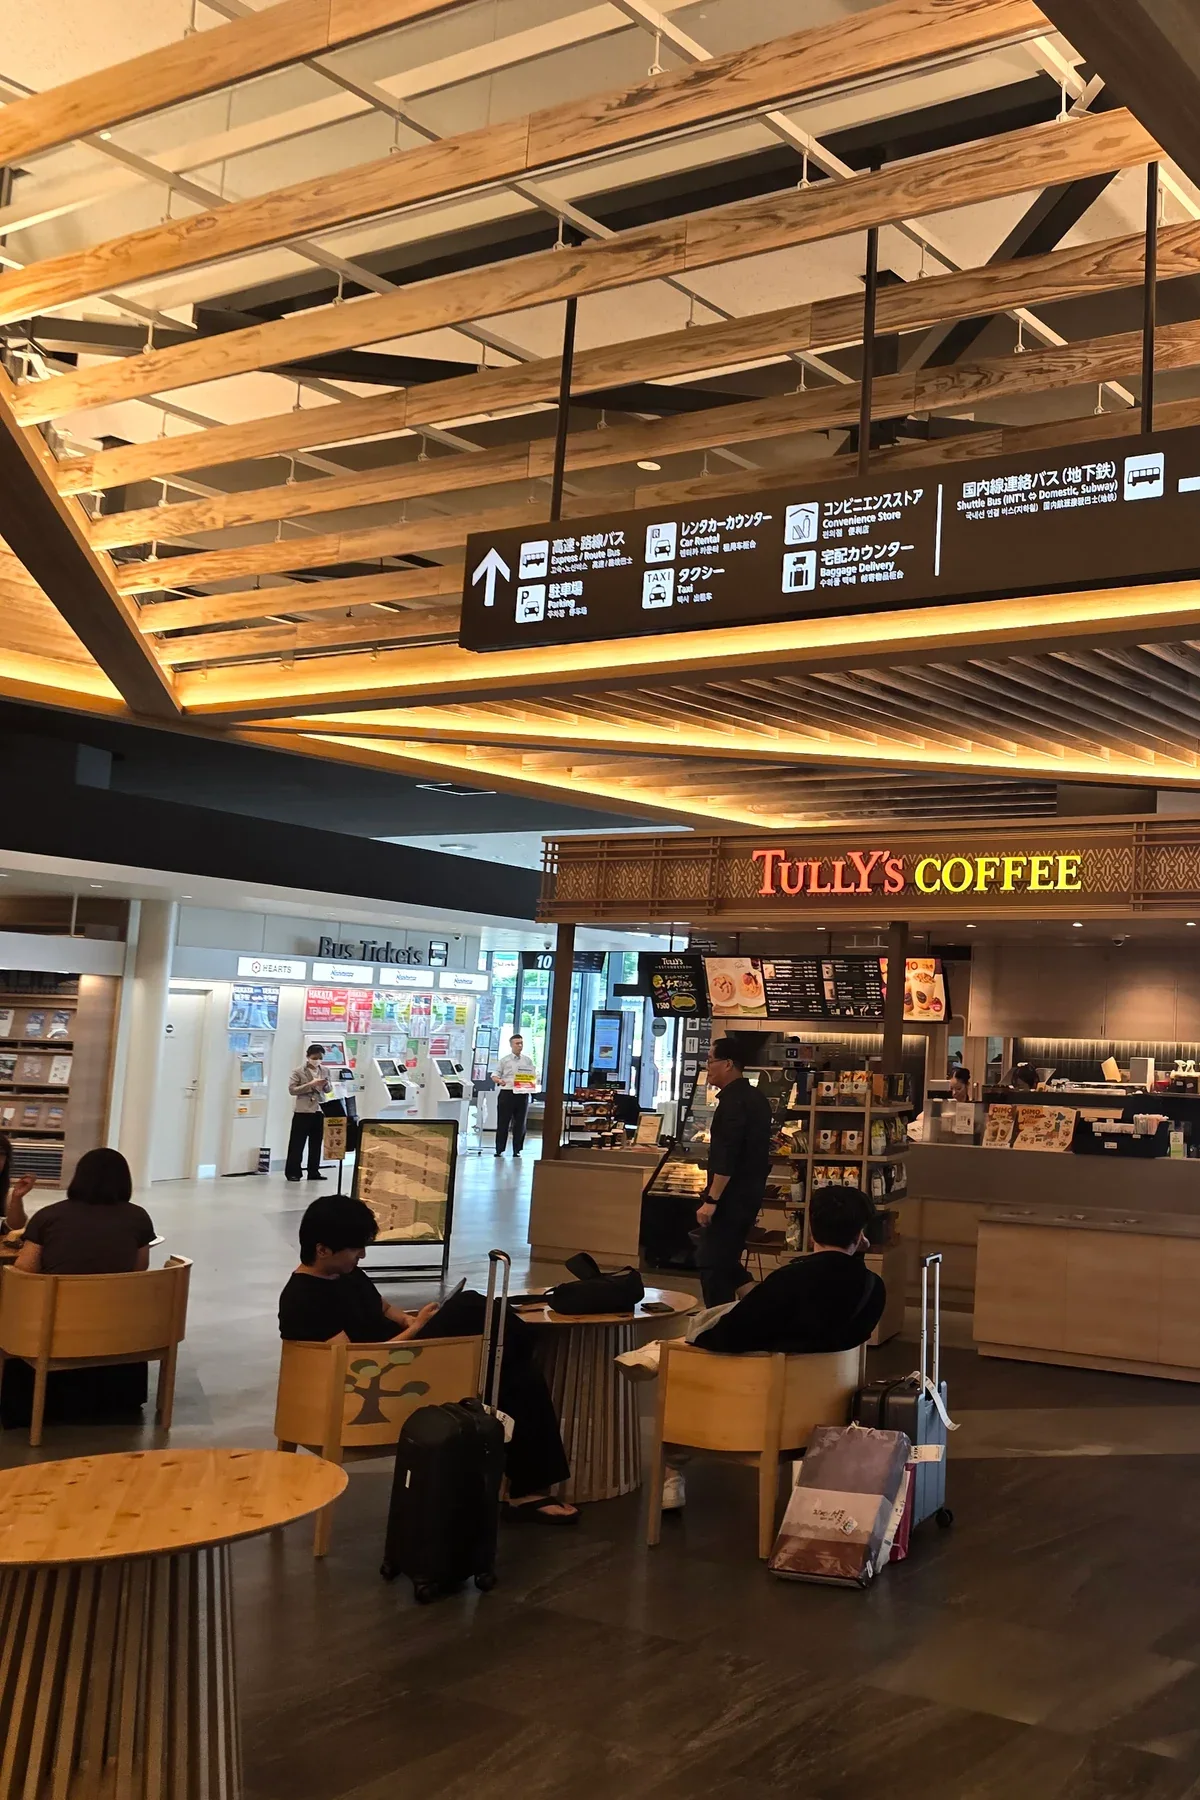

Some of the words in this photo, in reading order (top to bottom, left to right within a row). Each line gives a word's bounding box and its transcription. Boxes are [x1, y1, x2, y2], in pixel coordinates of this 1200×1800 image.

[823, 489, 923, 516] コンビニエンスストア
[957, 498, 985, 511] Shuttle
[987, 496, 1002, 507] Bus
[1003, 493, 1026, 506] (INT'L
[1039, 487, 1079, 499] Domestic,
[1081, 479, 1118, 494] Subway)
[681, 511, 772, 536] レンタカーカウンター
[822, 515, 876, 528] Convenience
[877, 510, 901, 522] Store
[680, 538, 694, 547] Car
[694, 533, 720, 546] Rental
[551, 554, 578, 565] Express
[584, 551, 606, 560] Route
[821, 541, 914, 566] 宅配カウンター
[647, 572, 671, 583] TAXI
[678, 565, 725, 583] タクシー
[820, 565, 857, 578] Baggage
[859, 561, 895, 573] Delivery
[677, 584, 693, 594] Taxi
[914, 855, 1082, 893] COFFEE
[318, 936, 354, 959] Bus
[360, 940, 423, 965] Tickets
[262, 964, 292, 974] HEARTS
[537, 954, 552, 969] 10
